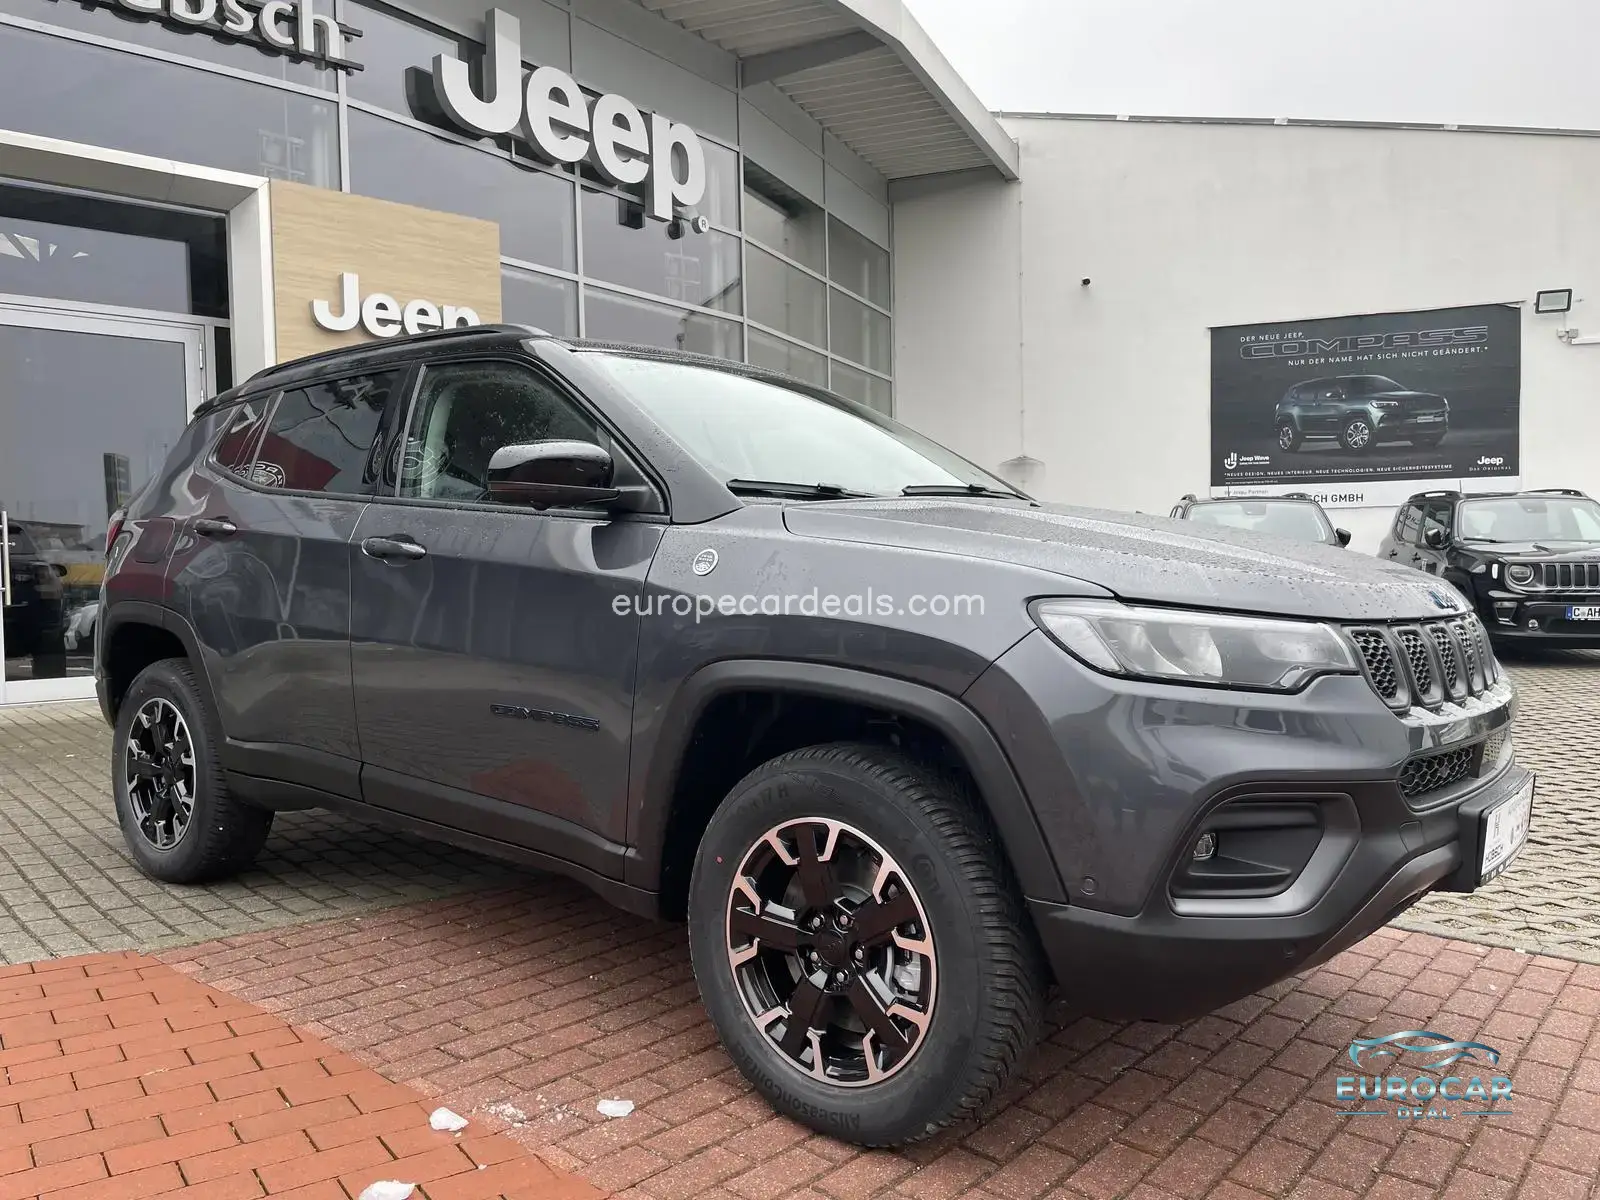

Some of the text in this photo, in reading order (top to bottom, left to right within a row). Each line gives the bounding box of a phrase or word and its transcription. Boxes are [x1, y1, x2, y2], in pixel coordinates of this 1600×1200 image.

[432, 8, 706, 222] Jeep
[1240, 335, 1256, 343] DER
[1259, 333, 1280, 341] NEUE
[1240, 325, 1488, 360] COMPASS
[1308, 357, 1325, 365] DER
[1328, 355, 1353, 363] NAME
[1377, 352, 1398, 360] SICH
[1401, 350, 1429, 358] NICHT
[1477, 456, 1503, 466] Jeep
[1331, 493, 1364, 503] GMBH
